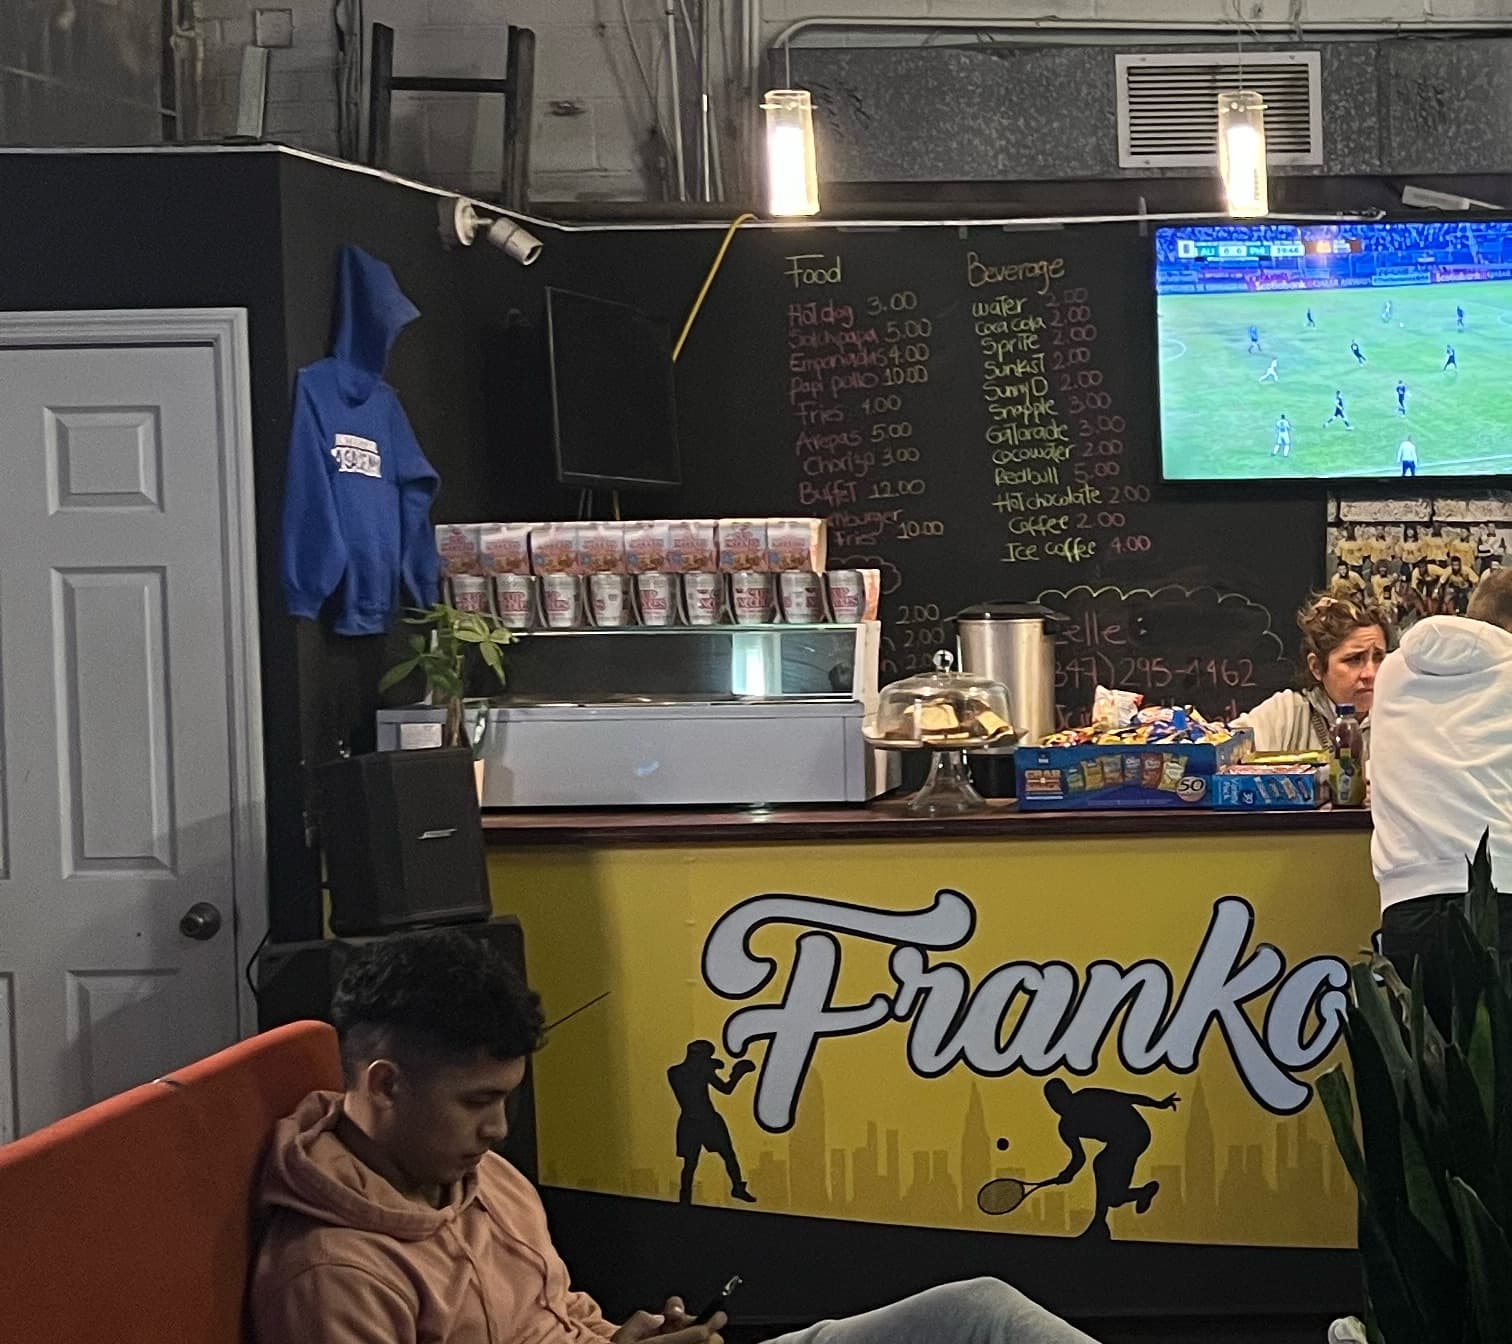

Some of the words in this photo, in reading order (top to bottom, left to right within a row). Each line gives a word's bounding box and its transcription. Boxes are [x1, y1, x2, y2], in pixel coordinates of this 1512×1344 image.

[783, 254, 842, 288] Food
[967, 251, 1065, 294] Beverage
[866, 290, 918, 317] 3.00
[1050, 305, 1092, 327] 2.00
[885, 317, 932, 343] 5.00
[981, 333, 1040, 362] Sprite
[1053, 324, 1097, 346] 2.00
[984, 353, 1046, 380] Sunkist
[866, 479, 926, 499] 12.00
[1008, 515, 1070, 536] Coffee
[1000, 542, 1041, 562] Ice
[1111, 534, 1151, 554] 4.00
[896, 603, 939, 625] 2.00
[1178, 778, 1205, 792] 50
